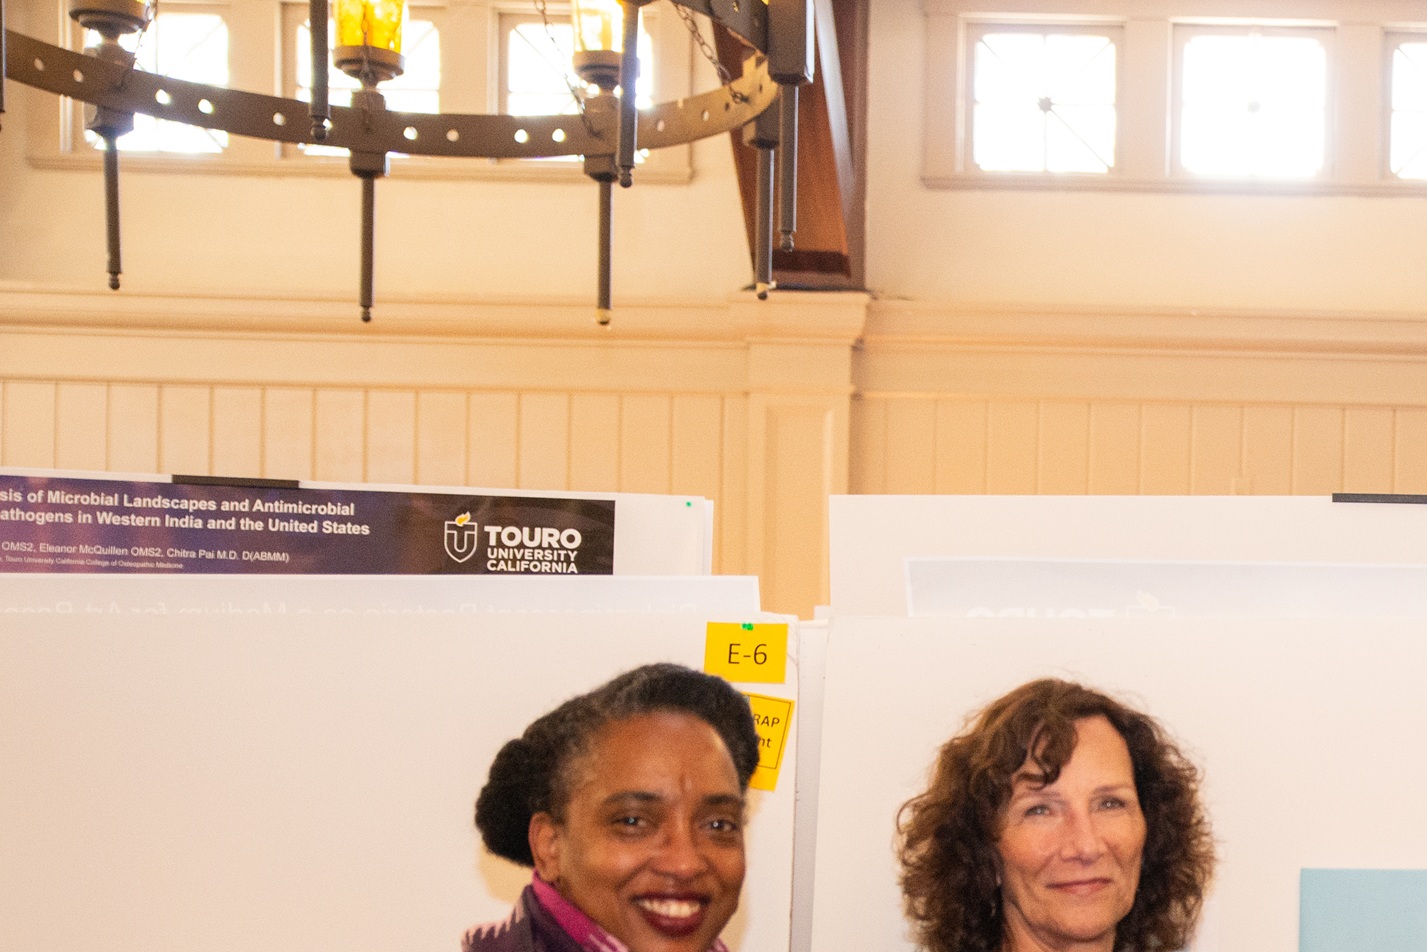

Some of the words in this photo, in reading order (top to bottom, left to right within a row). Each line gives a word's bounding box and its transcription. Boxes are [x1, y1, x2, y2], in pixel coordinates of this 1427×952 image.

[0, 490, 21, 501] sis
[27, 491, 42, 502] of
[47, 492, 118, 505] Microbial
[123, 495, 216, 513] Landscapes
[220, 499, 249, 511] and
[252, 500, 356, 516] Antimicrobial
[0, 509, 72, 526] athogens
[77, 512, 91, 524] in
[96, 513, 160, 526] Western
[164, 516, 202, 528] India
[207, 517, 235, 530] and
[239, 519, 263, 531] the
[268, 520, 318, 533] United
[322, 522, 370, 535] States
[484, 525, 582, 549] TOURO
[166, 548, 196, 558] Chitra
[198, 549, 214, 558] Pai
[487, 547, 578, 561] UNIVERSITY
[486, 559, 578, 573] CALIFORNIA
[728, 643, 768, 665] E-6
